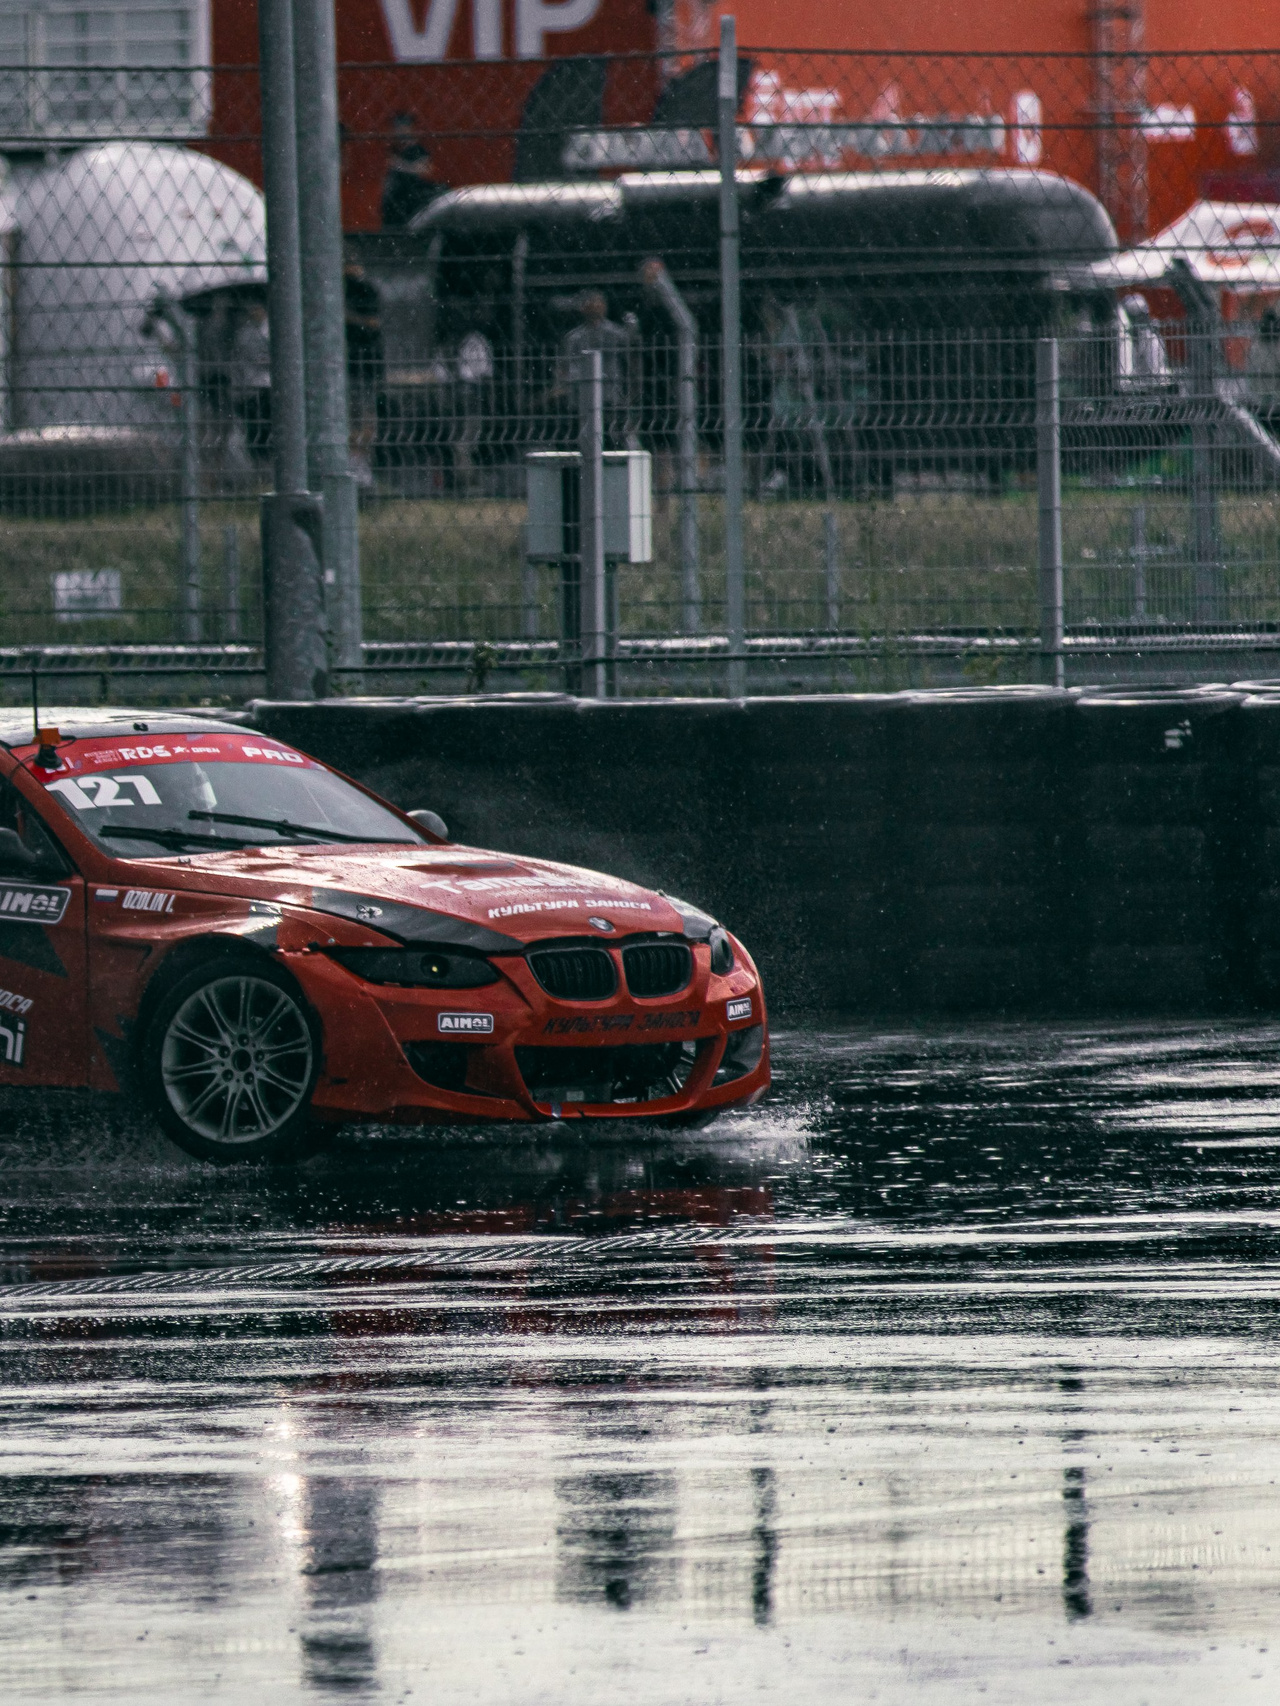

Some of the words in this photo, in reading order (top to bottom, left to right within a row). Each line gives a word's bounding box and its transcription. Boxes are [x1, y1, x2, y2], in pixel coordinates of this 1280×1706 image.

[382, 0, 601, 60] VIP
[44, 774, 162, 810] 127
[488, 900, 580, 918] КУЛЬТУРА
[584, 899, 652, 911] ЗАНОСА
[441, 1017, 490, 1030] AIMOL
